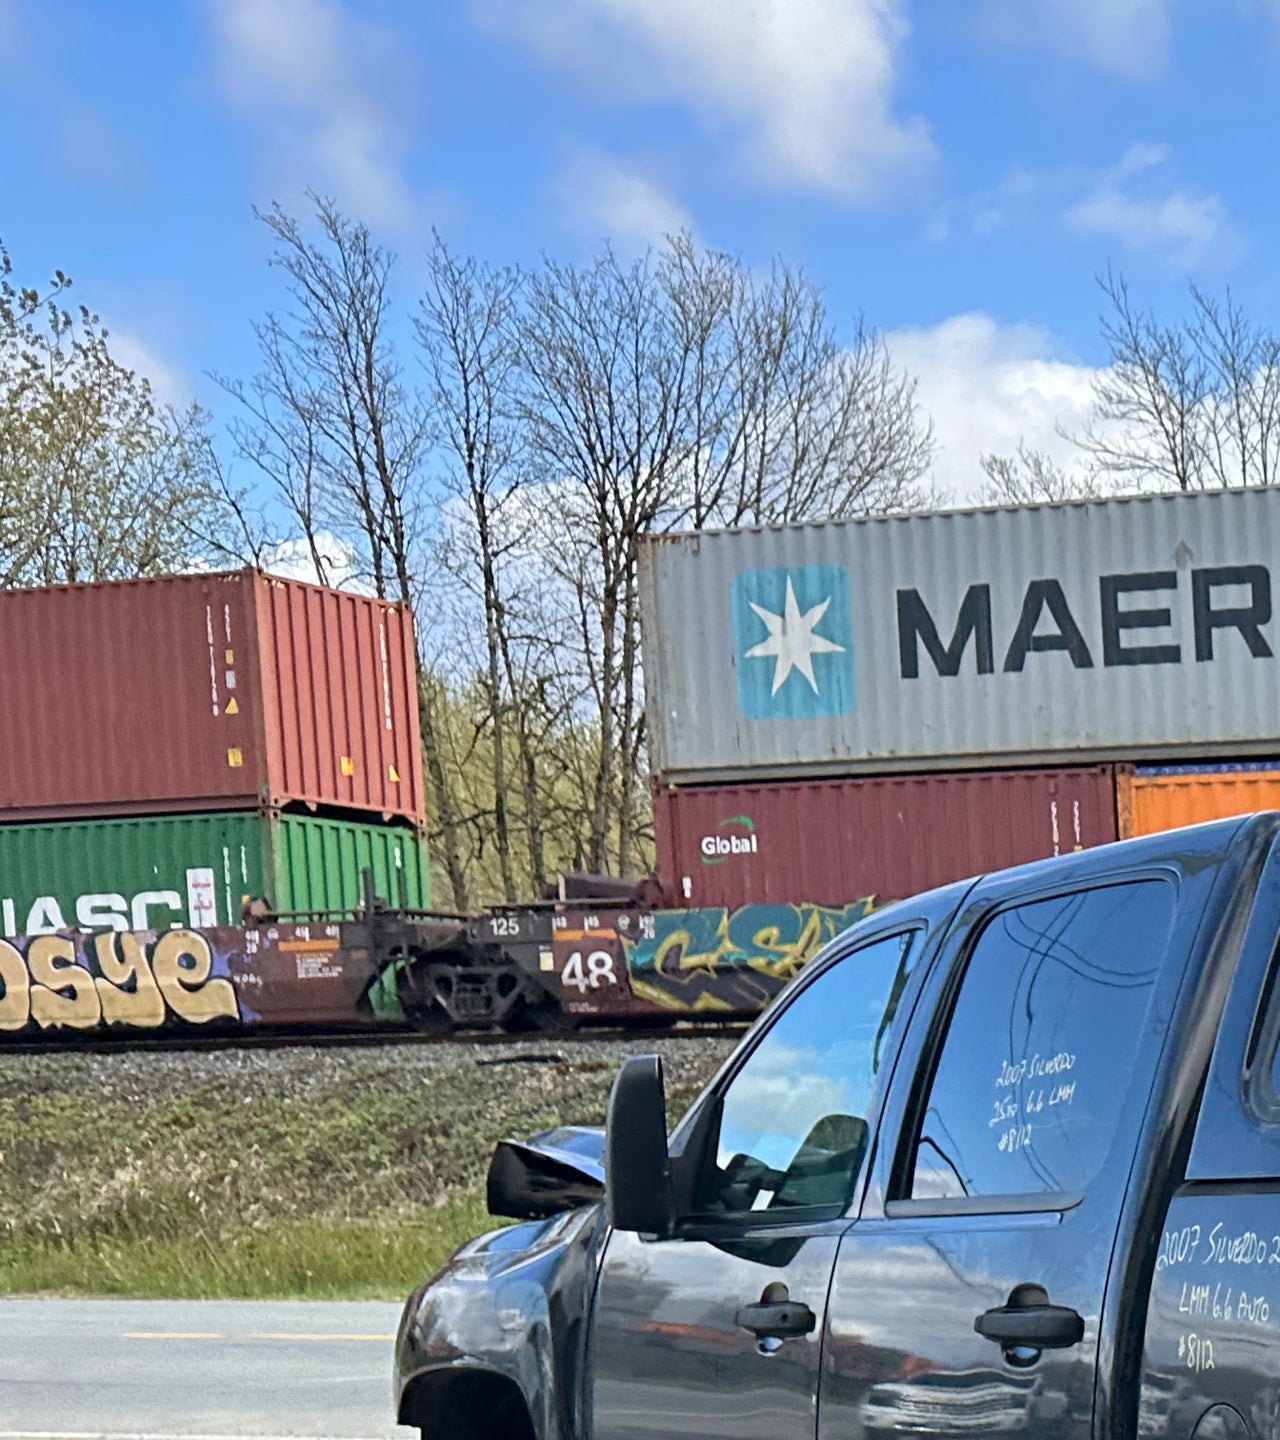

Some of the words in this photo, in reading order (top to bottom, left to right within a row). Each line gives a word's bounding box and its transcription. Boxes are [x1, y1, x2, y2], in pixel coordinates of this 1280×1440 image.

[701, 833, 757, 854] Global
[489, 917, 520, 936] 125
[560, 950, 618, 994] 48
[1155, 1224, 1200, 1271] 2007
[1178, 1281, 1210, 1315] LMM
[1211, 1281, 1232, 1321] 6.6
